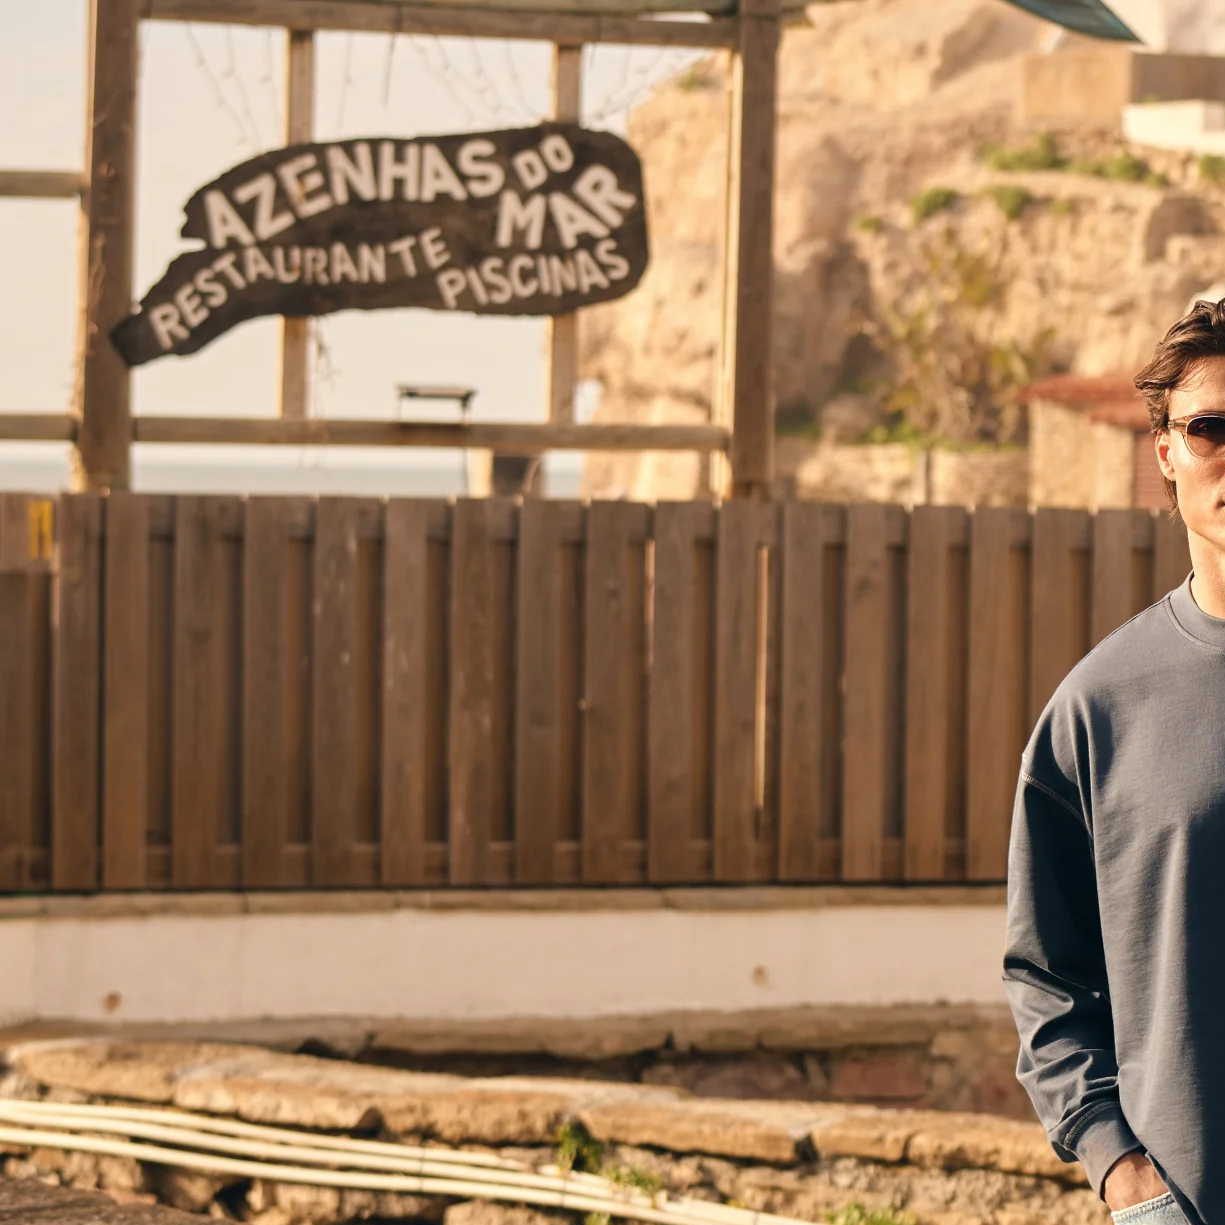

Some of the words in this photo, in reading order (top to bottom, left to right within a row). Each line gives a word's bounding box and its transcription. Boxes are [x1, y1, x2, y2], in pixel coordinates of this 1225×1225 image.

[204, 139, 505, 250] AZENHAS
[511, 134, 575, 190] DO
[495, 163, 637, 250] MAR
[148, 227, 452, 351] RESTAURANTE
[435, 239, 631, 309] PISCINAS
